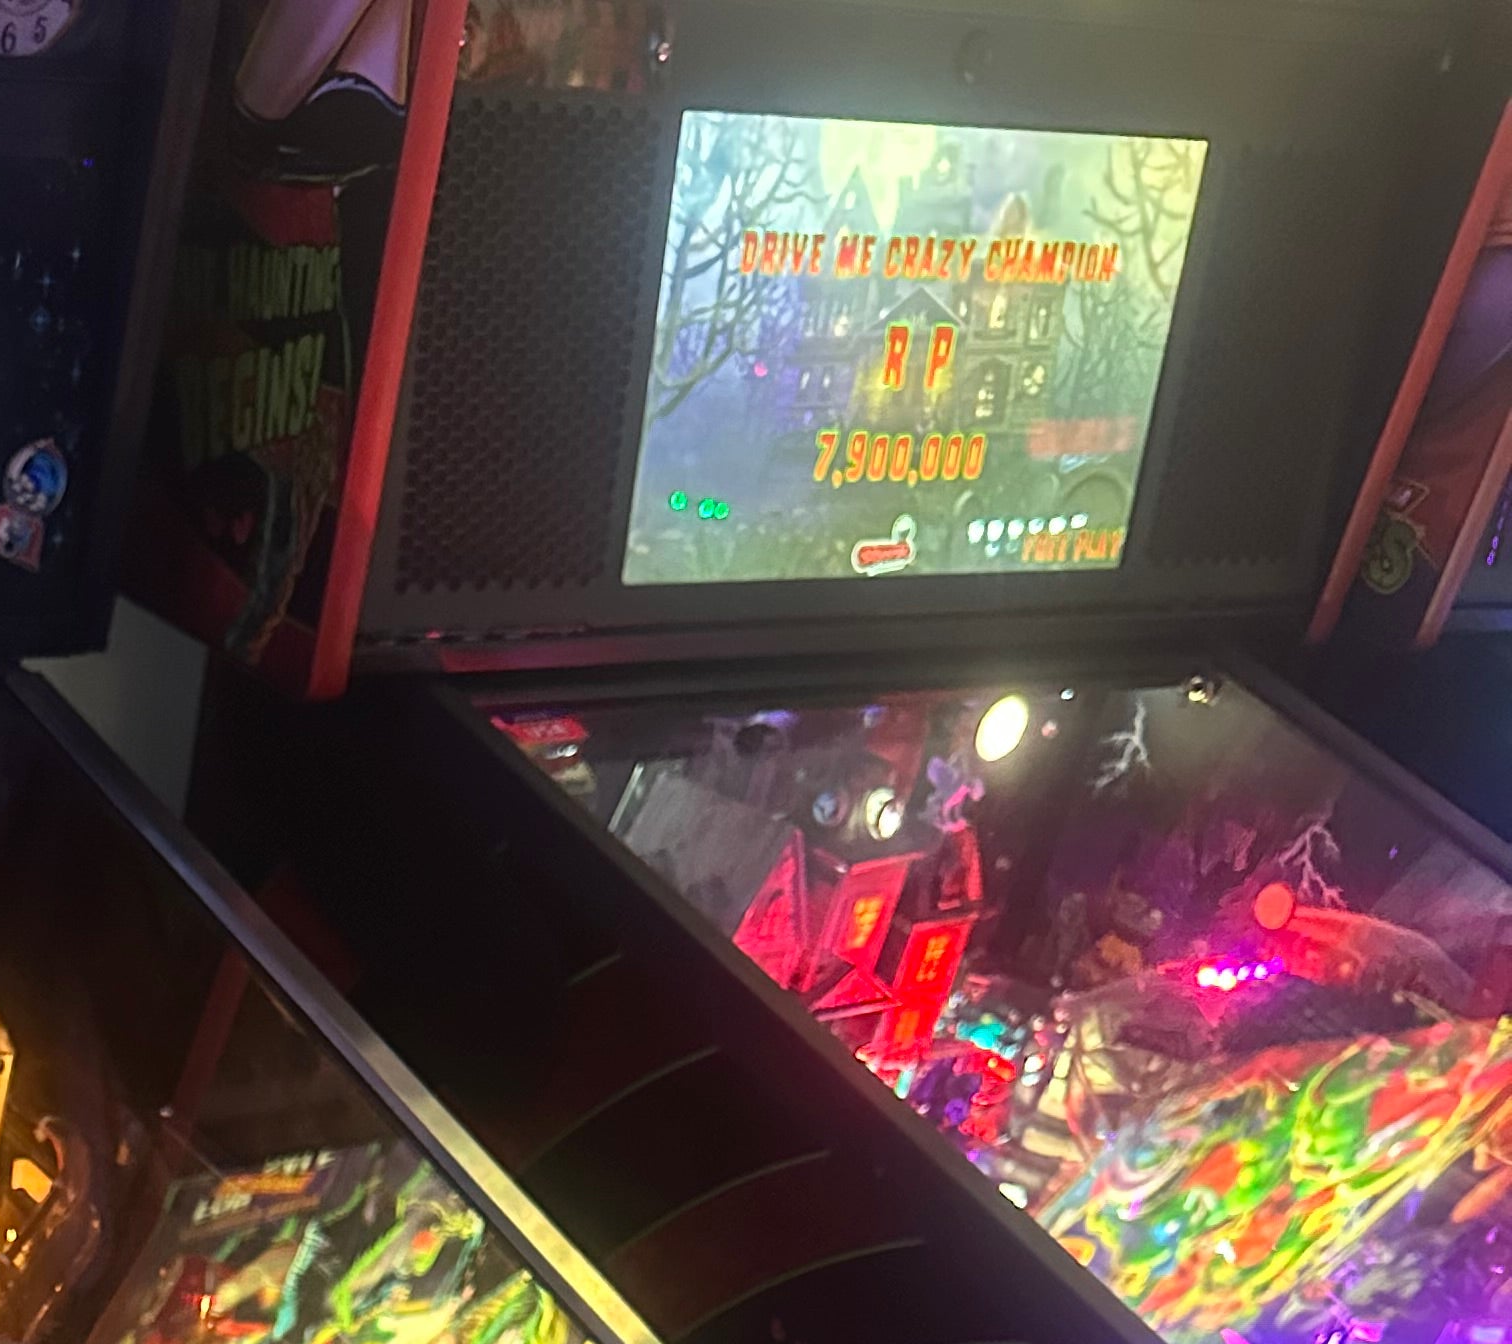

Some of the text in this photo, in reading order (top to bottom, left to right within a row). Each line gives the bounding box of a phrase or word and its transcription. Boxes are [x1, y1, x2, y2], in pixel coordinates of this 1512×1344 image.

[0, 22, 17, 53] 6
[31, 15, 48, 43] 5
[740, 230, 1122, 284] DRIVE ME CRAZY CHAMPION
[813, 430, 988, 489] 7,900,000
